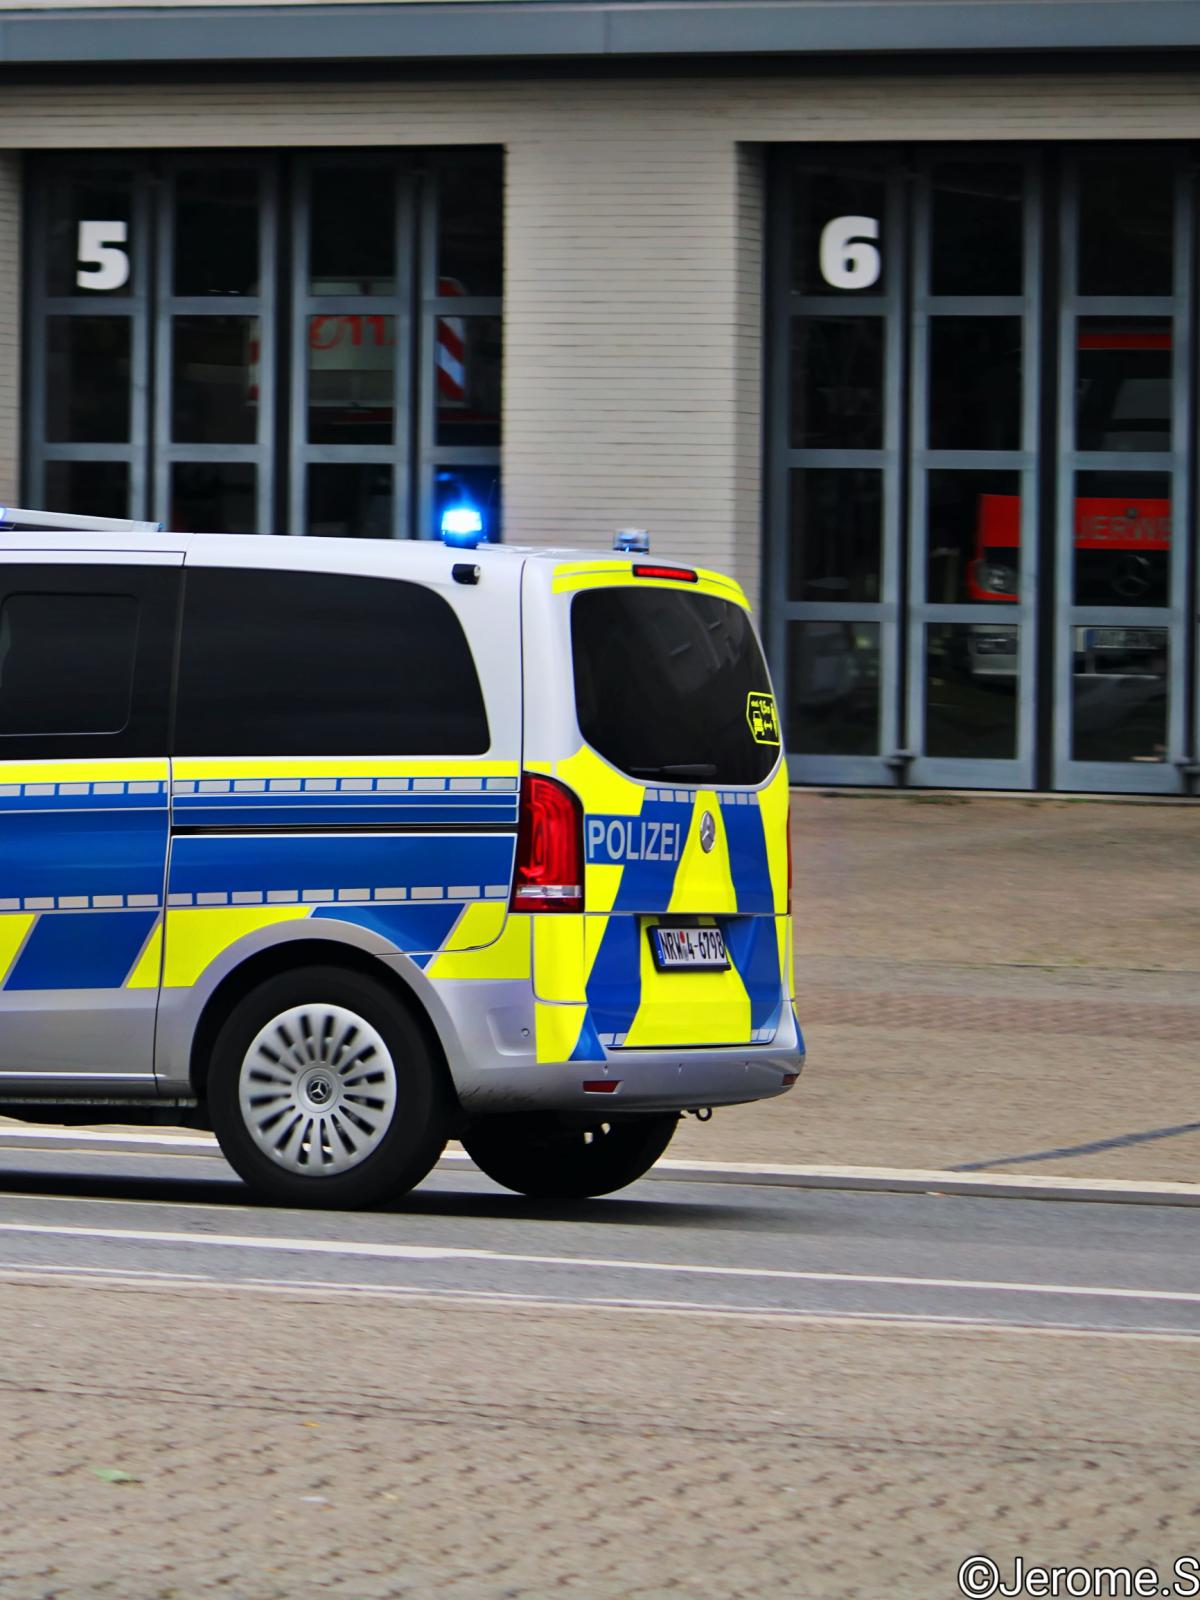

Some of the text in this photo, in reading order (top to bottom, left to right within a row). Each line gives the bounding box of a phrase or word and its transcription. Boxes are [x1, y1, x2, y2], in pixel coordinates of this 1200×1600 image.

[76, 220, 130, 290] 5
[819, 215, 881, 290] 6
[588, 819, 681, 862] POLIZEI
[660, 931, 725, 960] NRW 4-6798
